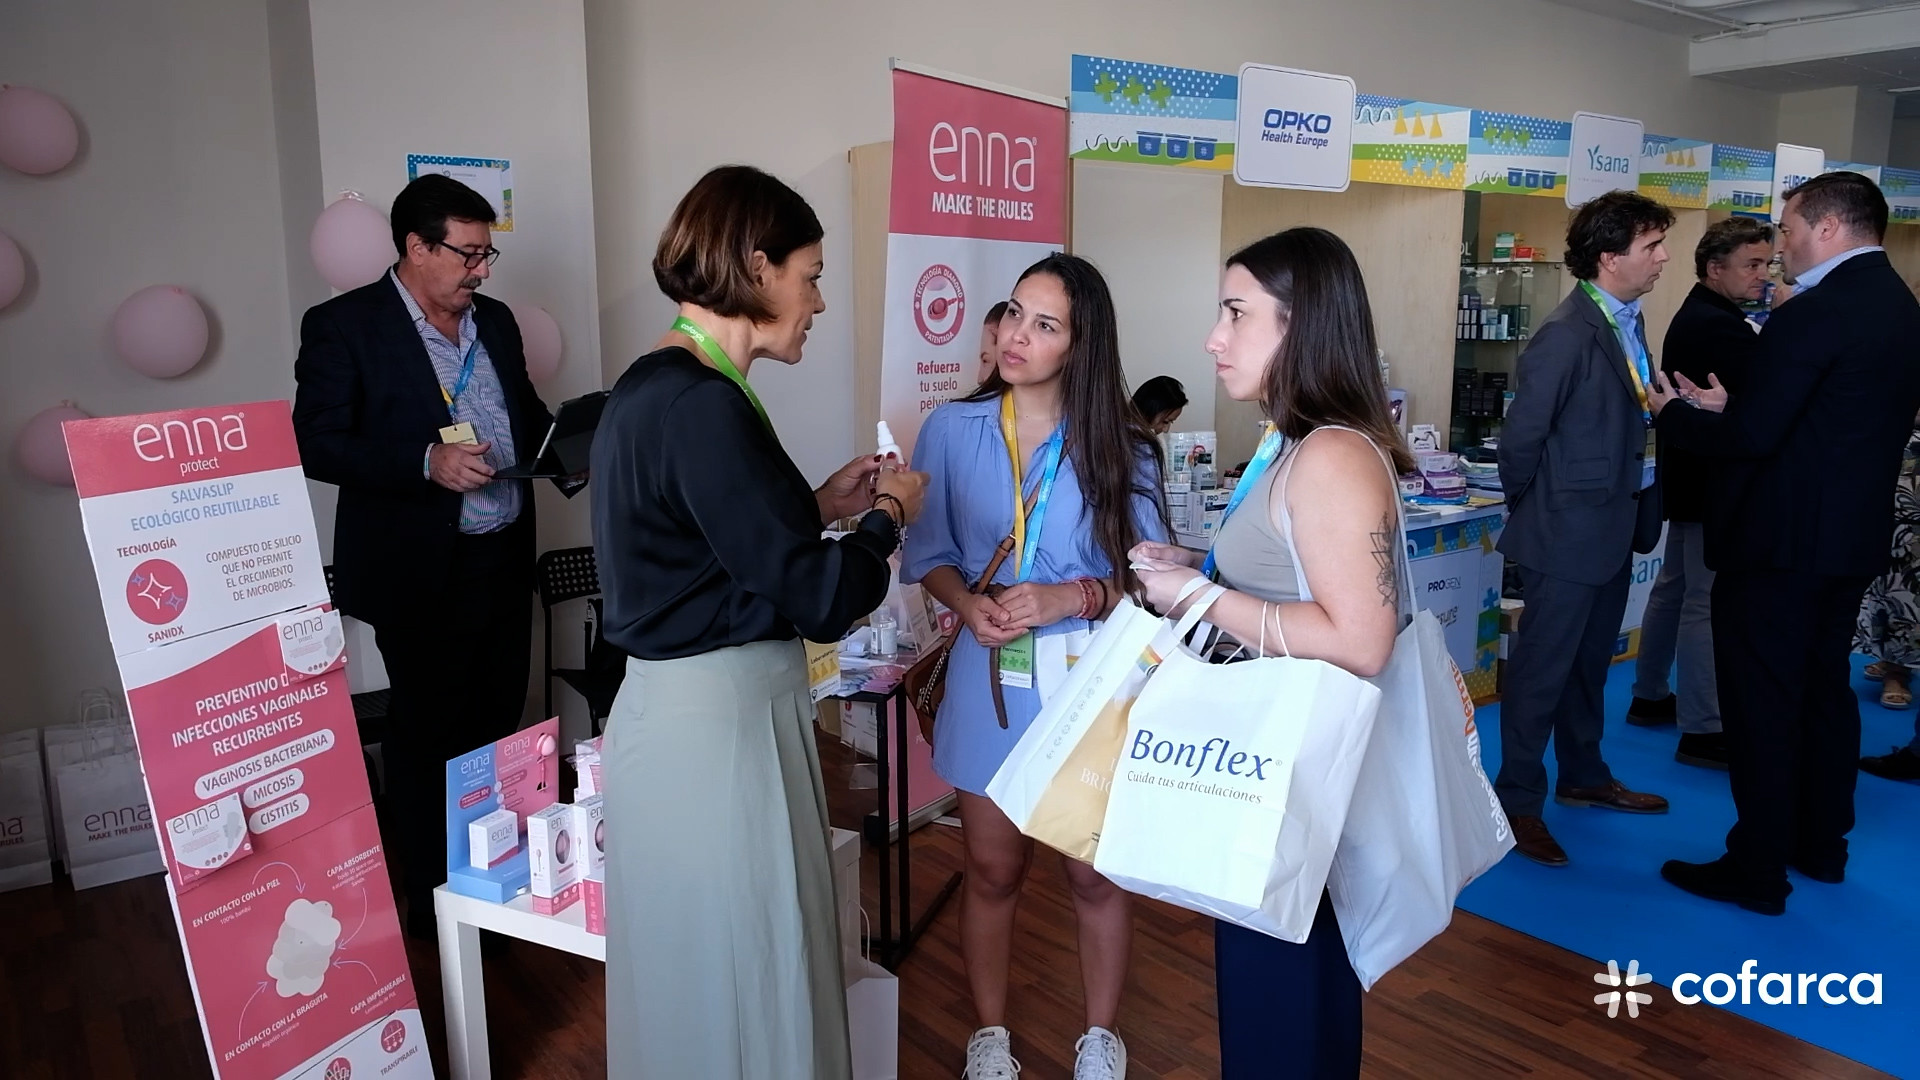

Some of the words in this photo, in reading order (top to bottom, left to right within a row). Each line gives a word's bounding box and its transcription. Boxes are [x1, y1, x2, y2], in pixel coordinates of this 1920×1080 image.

[1264, 109, 1331, 133] OPKO
[1261, 130, 1293, 143] Health
[1296, 133, 1328, 149] Europe
[930, 122, 1035, 192] enna
[1588, 144, 1629, 173] Ysana
[932, 192, 972, 215] MAKE
[976, 197, 995, 217] THE
[998, 199, 1033, 221] RULES
[925, 331, 954, 343] PATENTADA
[916, 361, 960, 374] Refuerza
[920, 382, 930, 392] tu
[932, 378, 958, 390] suelo
[133, 412, 248, 462] enna
[180, 456, 219, 476] protect
[171, 482, 235, 504] SALVASLIP
[131, 507, 200, 531] ECOLÓGICO
[203, 493, 280, 519] REUTILIZABLE
[117, 537, 177, 558] TECNOLOGÍA
[205, 544, 259, 564] COMPUESTO
[260, 541, 272, 553] DE
[274, 534, 302, 551] SILICIO
[221, 561, 240, 575] QUE
[241, 558, 255, 570] NO
[256, 550, 293, 567] PERMITE
[226, 577, 237, 588] EL
[238, 564, 294, 586] CRECIMIENTO
[233, 590, 244, 601] DE
[246, 580, 296, 600] MICROBIOS.
[148, 625, 185, 643] SANIDX
[283, 617, 323, 640] enna
[195, 677, 278, 715] PREVENTIVO
[171, 705, 258, 748] INFECCIONES
[260, 681, 329, 716] VAGINALES
[212, 712, 303, 757] RECURRENTES
[504, 737, 530, 756] enna
[202, 755, 263, 792] VAGINOSIS
[263, 733, 329, 769] BACTERIANA
[461, 753, 490, 774] enna
[1130, 729, 1272, 780] Bonflex
[252, 774, 296, 801] MICOSIS
[1127, 770, 1155, 785] Cuida
[1158, 776, 1174, 788] tus
[1178, 780, 1262, 804] articulaciones
[84, 803, 152, 833] enna
[172, 803, 220, 834] enna
[260, 800, 300, 826] CISTITIS
[115, 826, 128, 835] THE
[491, 824, 513, 841] enna
[326, 865, 343, 878] CAPA
[343, 845, 381, 869] ABSORBENTE
[192, 917, 203, 928] EN
[204, 898, 241, 922] CONTACTO
[241, 890, 256, 903] CON
[256, 886, 266, 895] LA
[266, 878, 281, 891] PIEL
[350, 1000, 366, 1015] CAPA
[366, 973, 407, 1006] IMPERMEABLE
[224, 1051, 236, 1062] EN
[235, 1027, 271, 1055] CONTACTO
[271, 1018, 286, 1032] CON
[286, 1013, 296, 1023] LA
[296, 992, 329, 1017] BRAGUITA
[380, 1045, 419, 1076] TRANSPIRABLE
